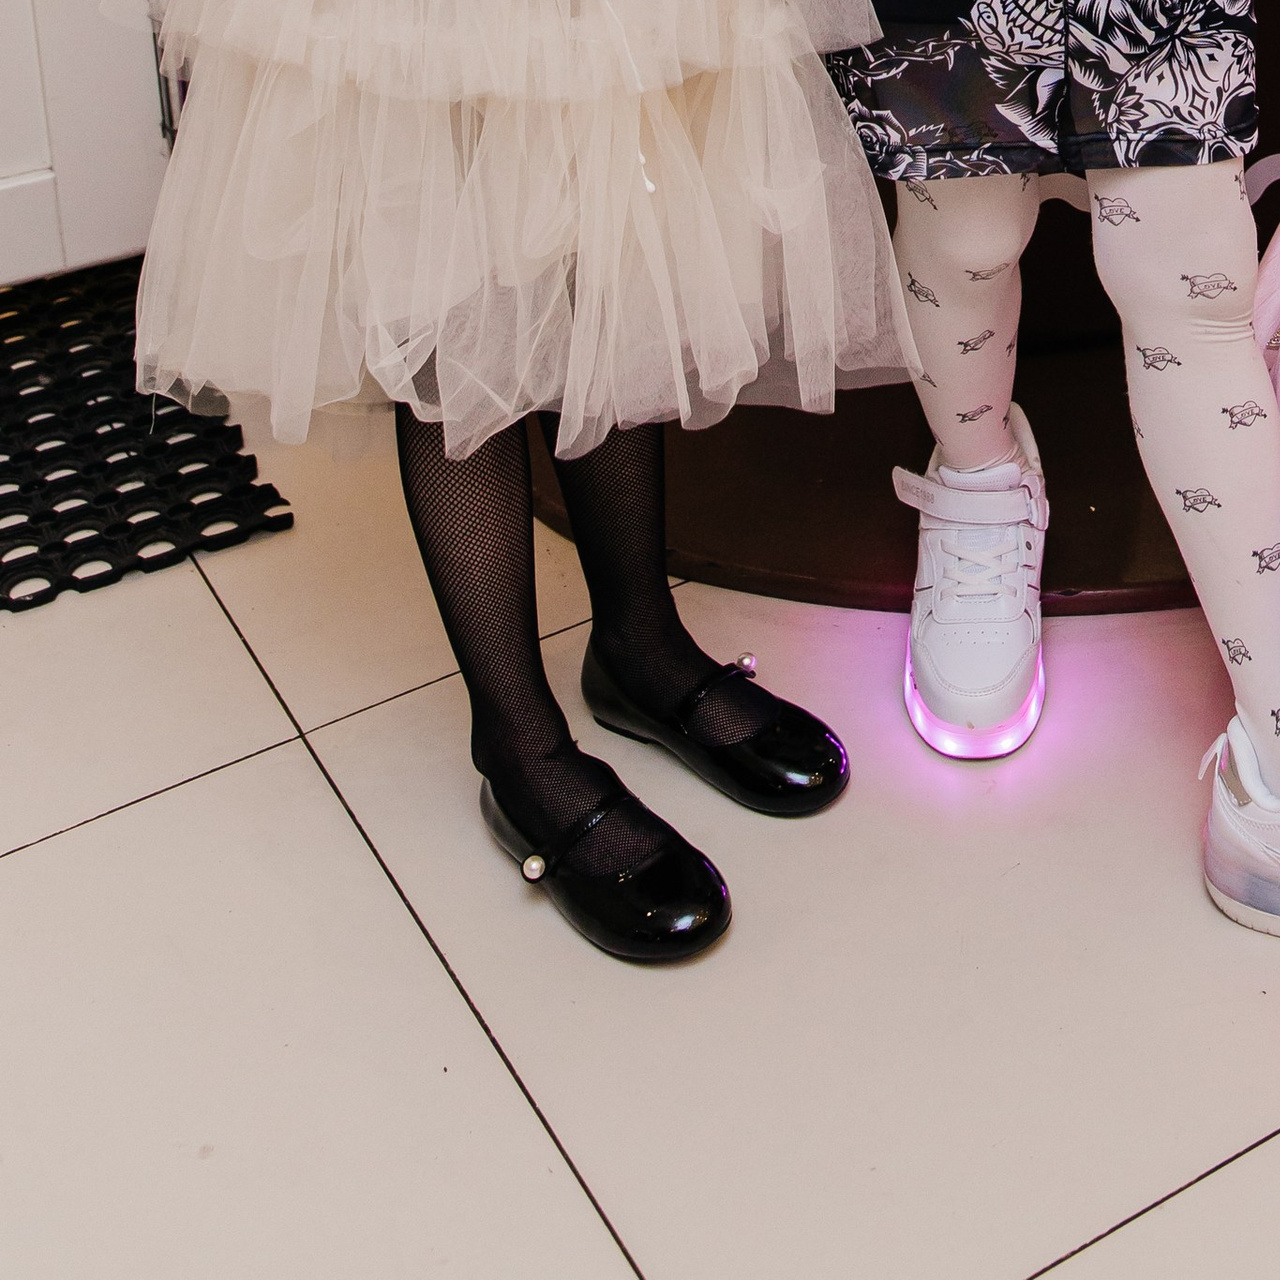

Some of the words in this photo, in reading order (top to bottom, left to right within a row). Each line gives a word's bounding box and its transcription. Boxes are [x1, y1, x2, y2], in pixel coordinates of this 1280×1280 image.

[1104, 207, 1125, 215] LOVE
[1148, 354, 1167, 363] LOVE
[1236, 408, 1255, 420] LOVE
[1189, 496, 1207, 505] LOVE
[1230, 647, 1242, 656] LOVE
